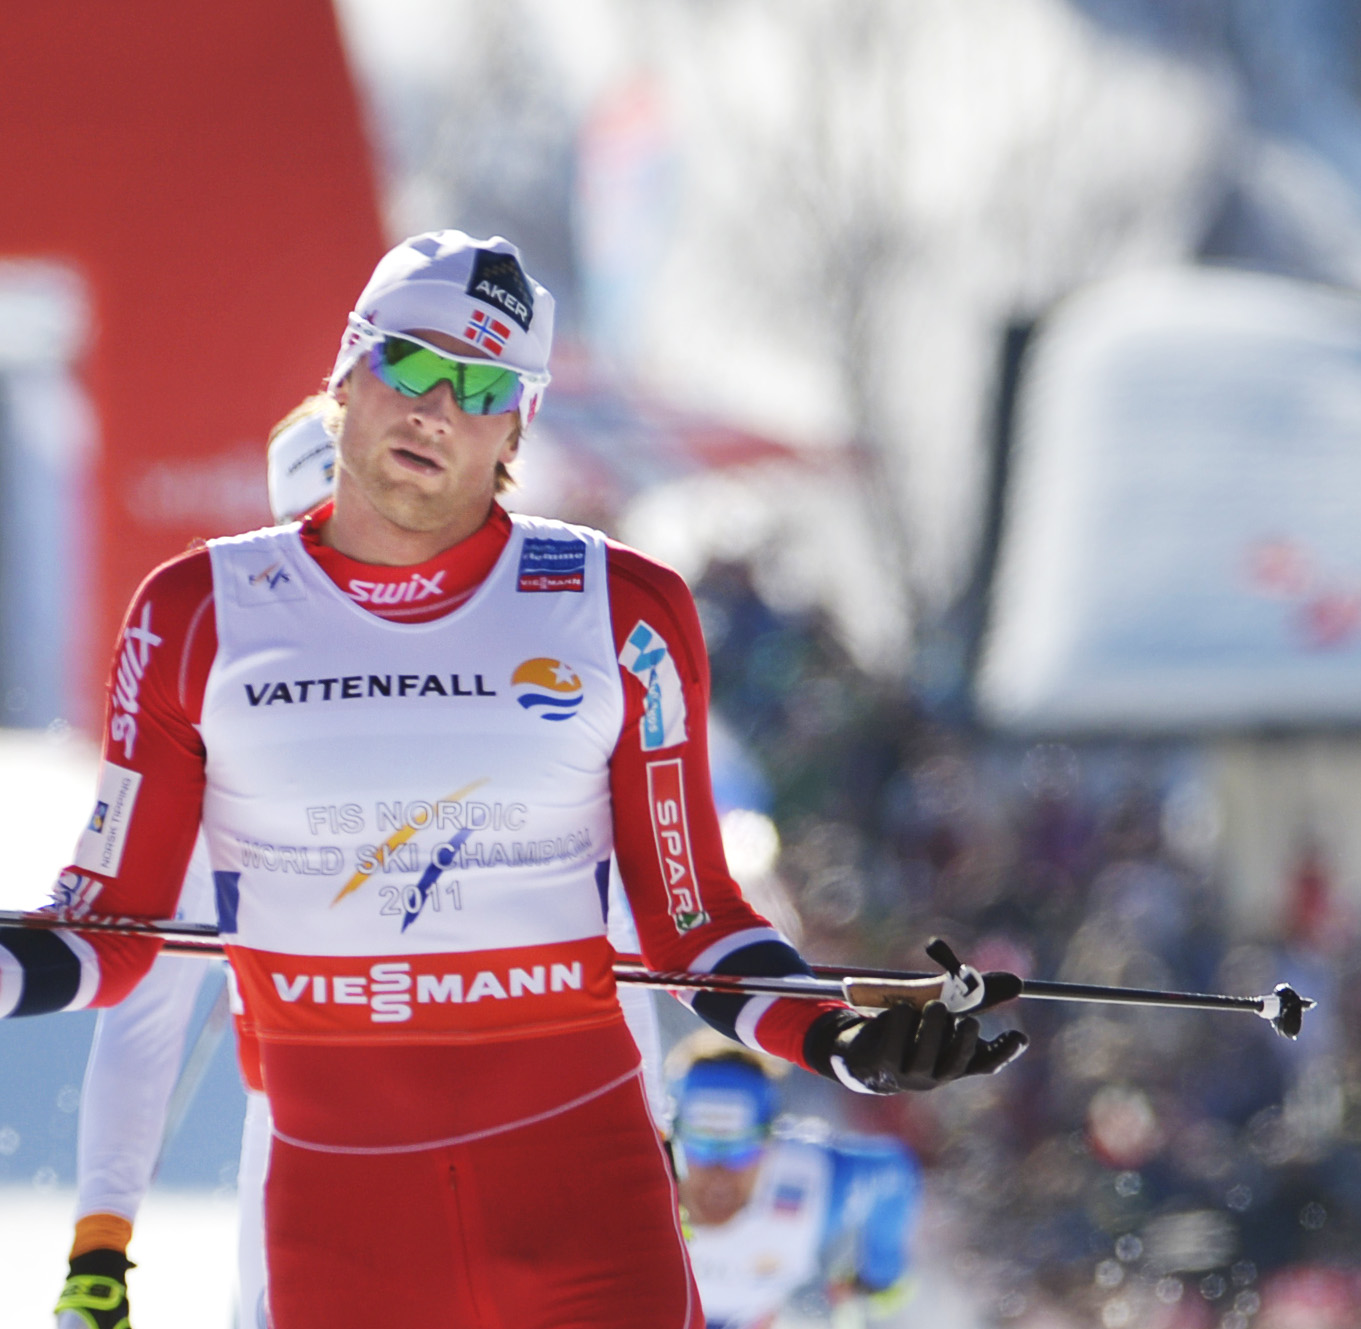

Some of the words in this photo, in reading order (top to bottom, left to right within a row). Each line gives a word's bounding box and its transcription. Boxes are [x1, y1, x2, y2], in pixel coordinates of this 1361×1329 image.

[476, 280, 528, 322] AKER
[244, 674, 497, 706] VATTENFALL
[305, 803, 366, 835] FIS
[376, 801, 528, 832] NORDIC
[238, 844, 344, 876] WORLD
[356, 844, 419, 875] SKI
[656, 799, 694, 914] SPAR
[378, 881, 463, 916] 2011
